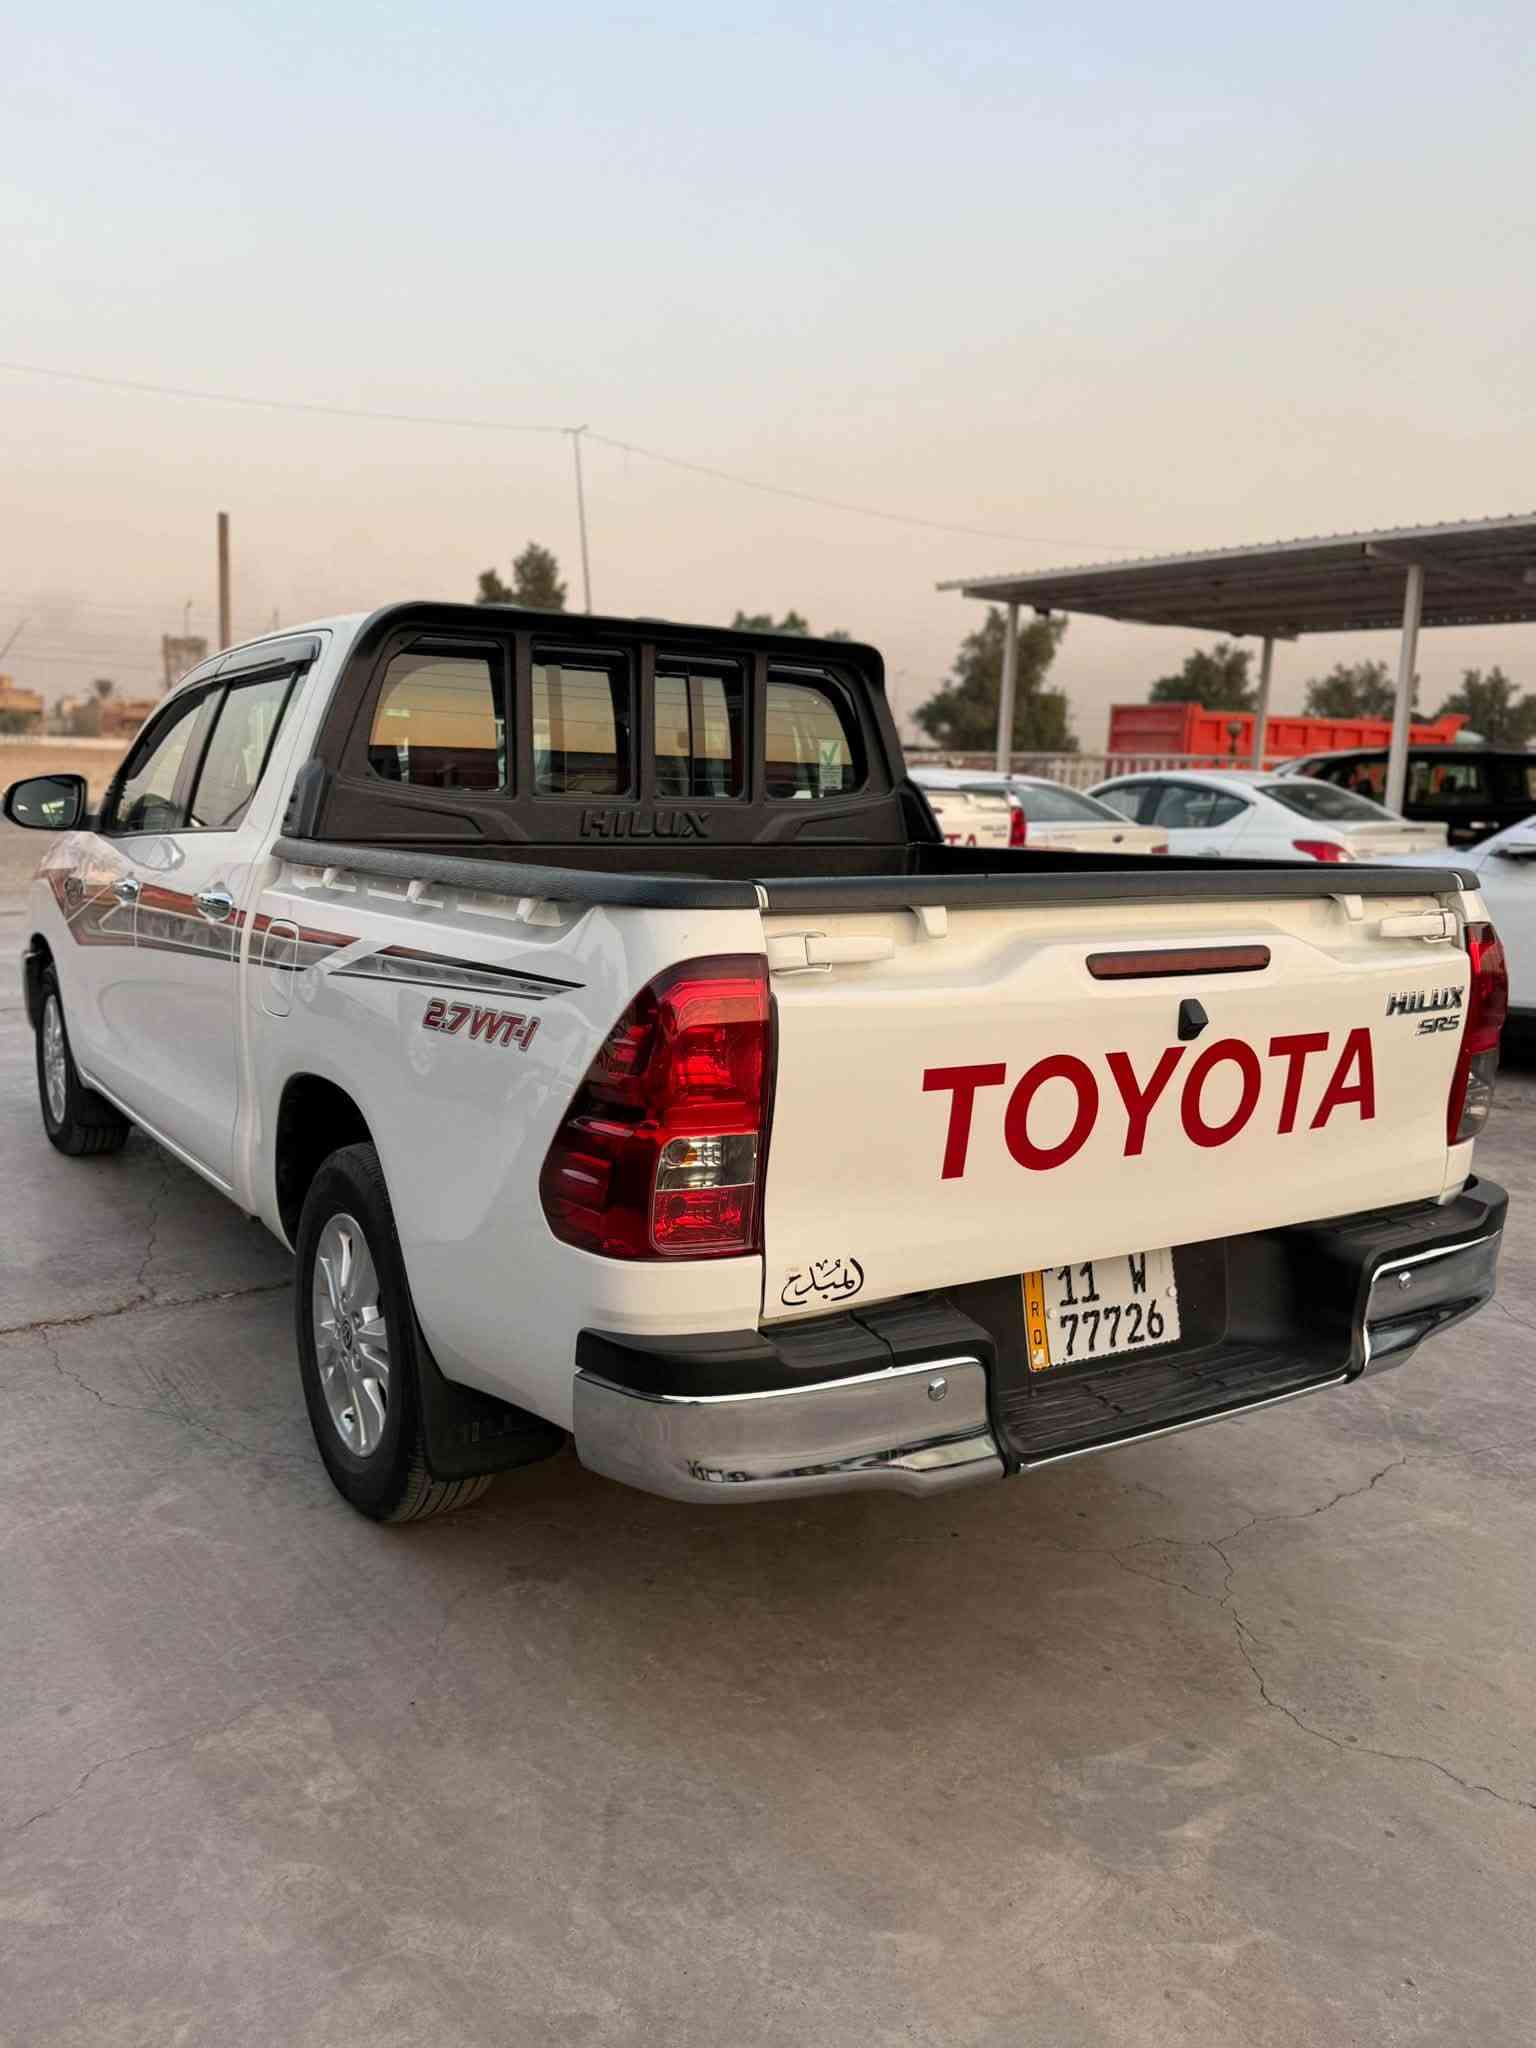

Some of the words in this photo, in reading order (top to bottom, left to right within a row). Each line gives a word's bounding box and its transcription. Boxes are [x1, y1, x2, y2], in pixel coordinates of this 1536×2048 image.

[578, 810, 711, 838] HILUX
[1384, 985, 1464, 1016] HILUX
[922, 1027, 1376, 1180] TOYOTA
[1057, 1261, 1100, 1307] 11
[1128, 1252, 1146, 1294] W
[1060, 1299, 1164, 1356] 77726
